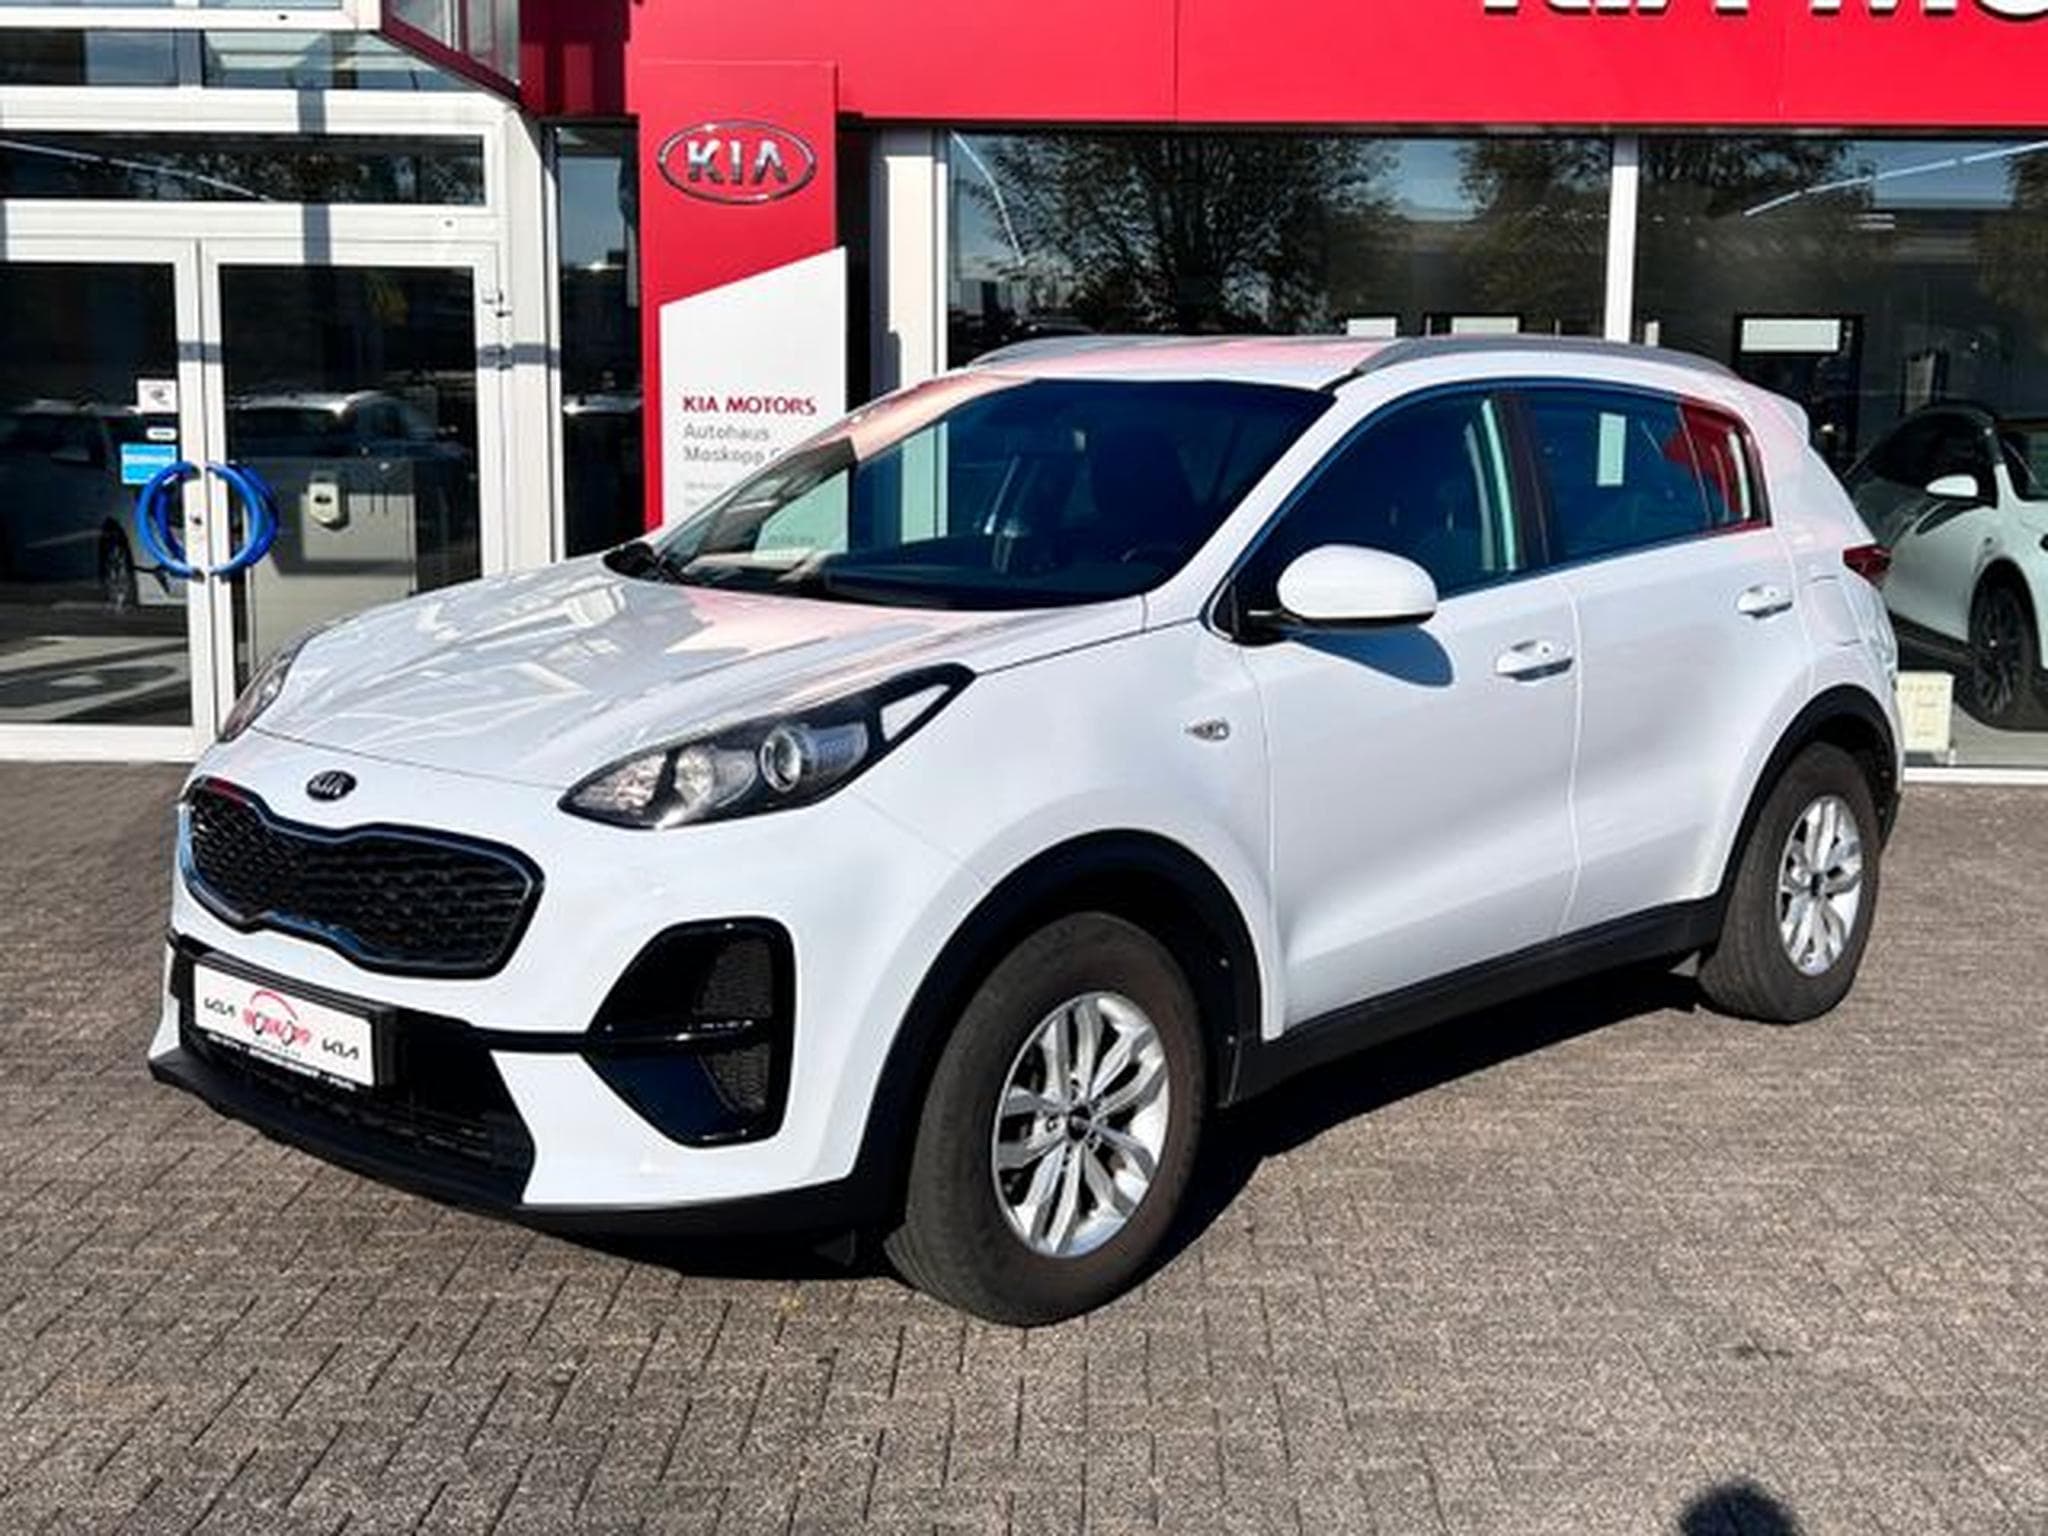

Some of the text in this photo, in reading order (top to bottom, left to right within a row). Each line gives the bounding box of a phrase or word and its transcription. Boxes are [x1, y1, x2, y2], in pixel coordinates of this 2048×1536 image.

[686, 138, 788, 185] KIA
[683, 396, 817, 415] KIA MOTORS
[684, 423, 770, 441] Autohaus
